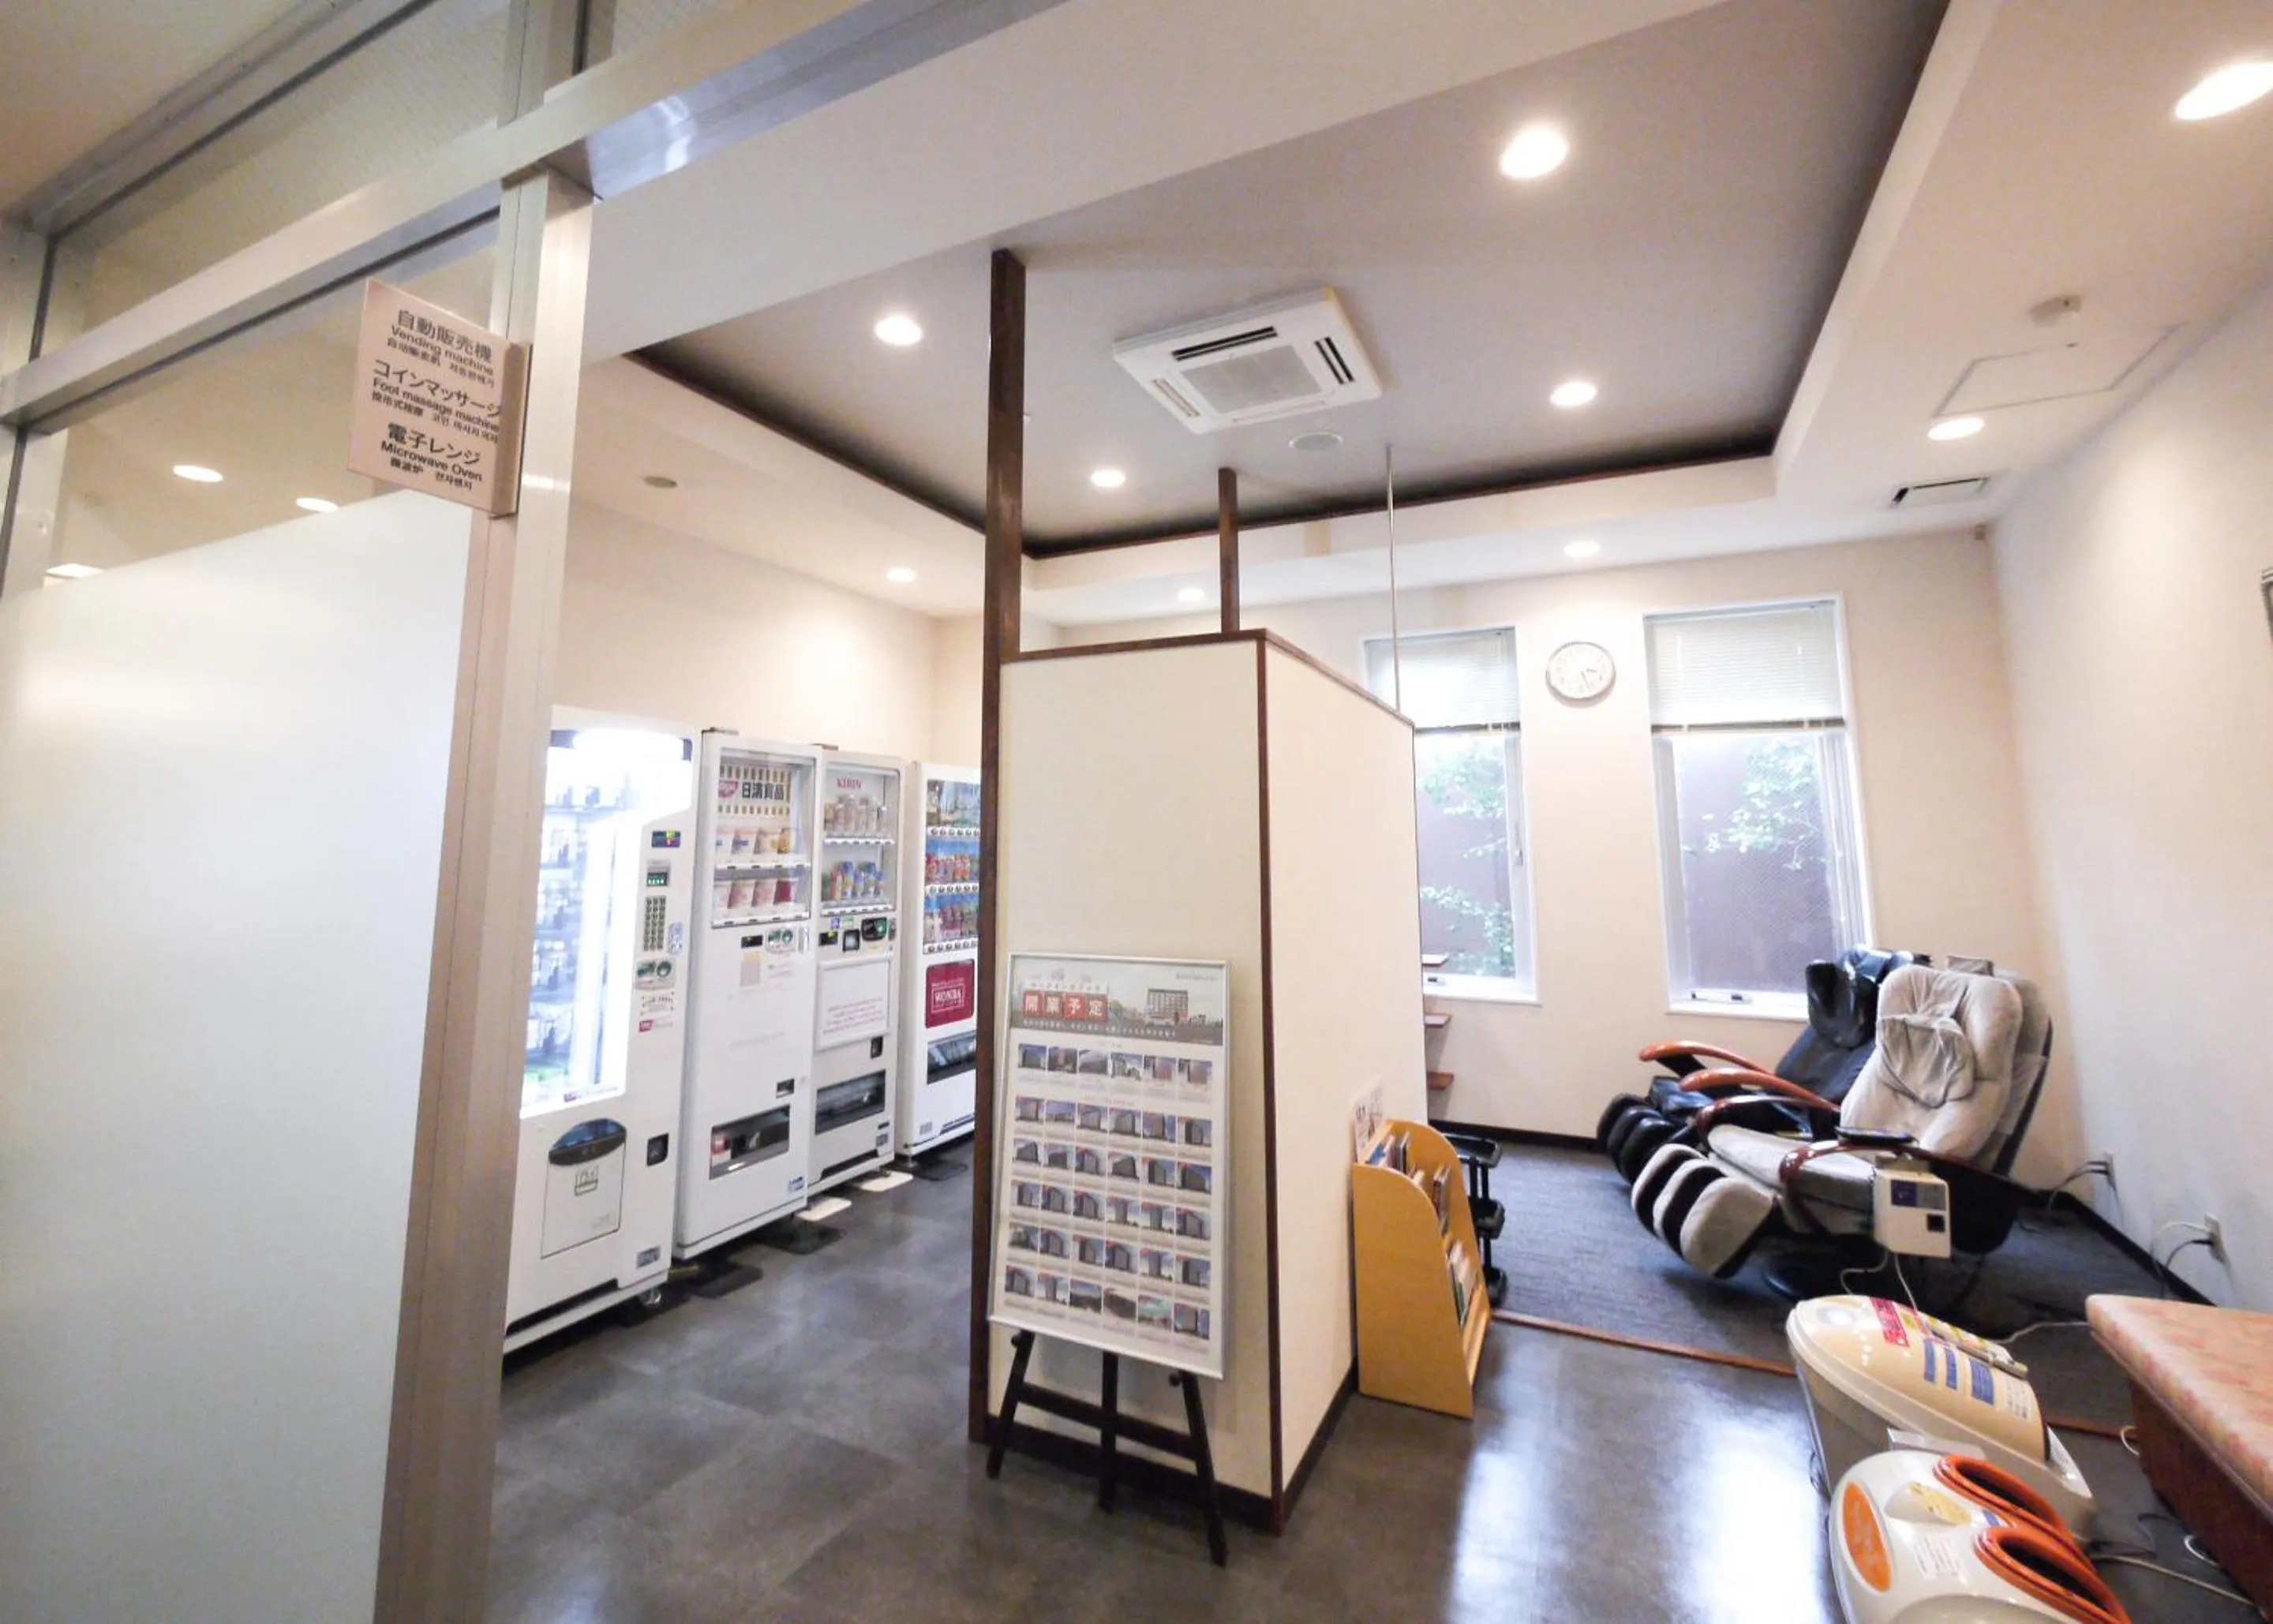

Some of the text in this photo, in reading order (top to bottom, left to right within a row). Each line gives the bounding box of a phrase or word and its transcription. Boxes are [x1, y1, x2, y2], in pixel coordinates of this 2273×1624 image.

[391, 324, 493, 376] Vending machine
[398, 309, 492, 364] 自動販売機
[373, 358, 500, 418] コインマッサージ
[373, 376, 500, 432] Foot massage machine
[381, 440, 482, 482] Microwave Oven
[388, 421, 481, 465] 電子レンジ
[837, 776, 863, 790] KIRIN
